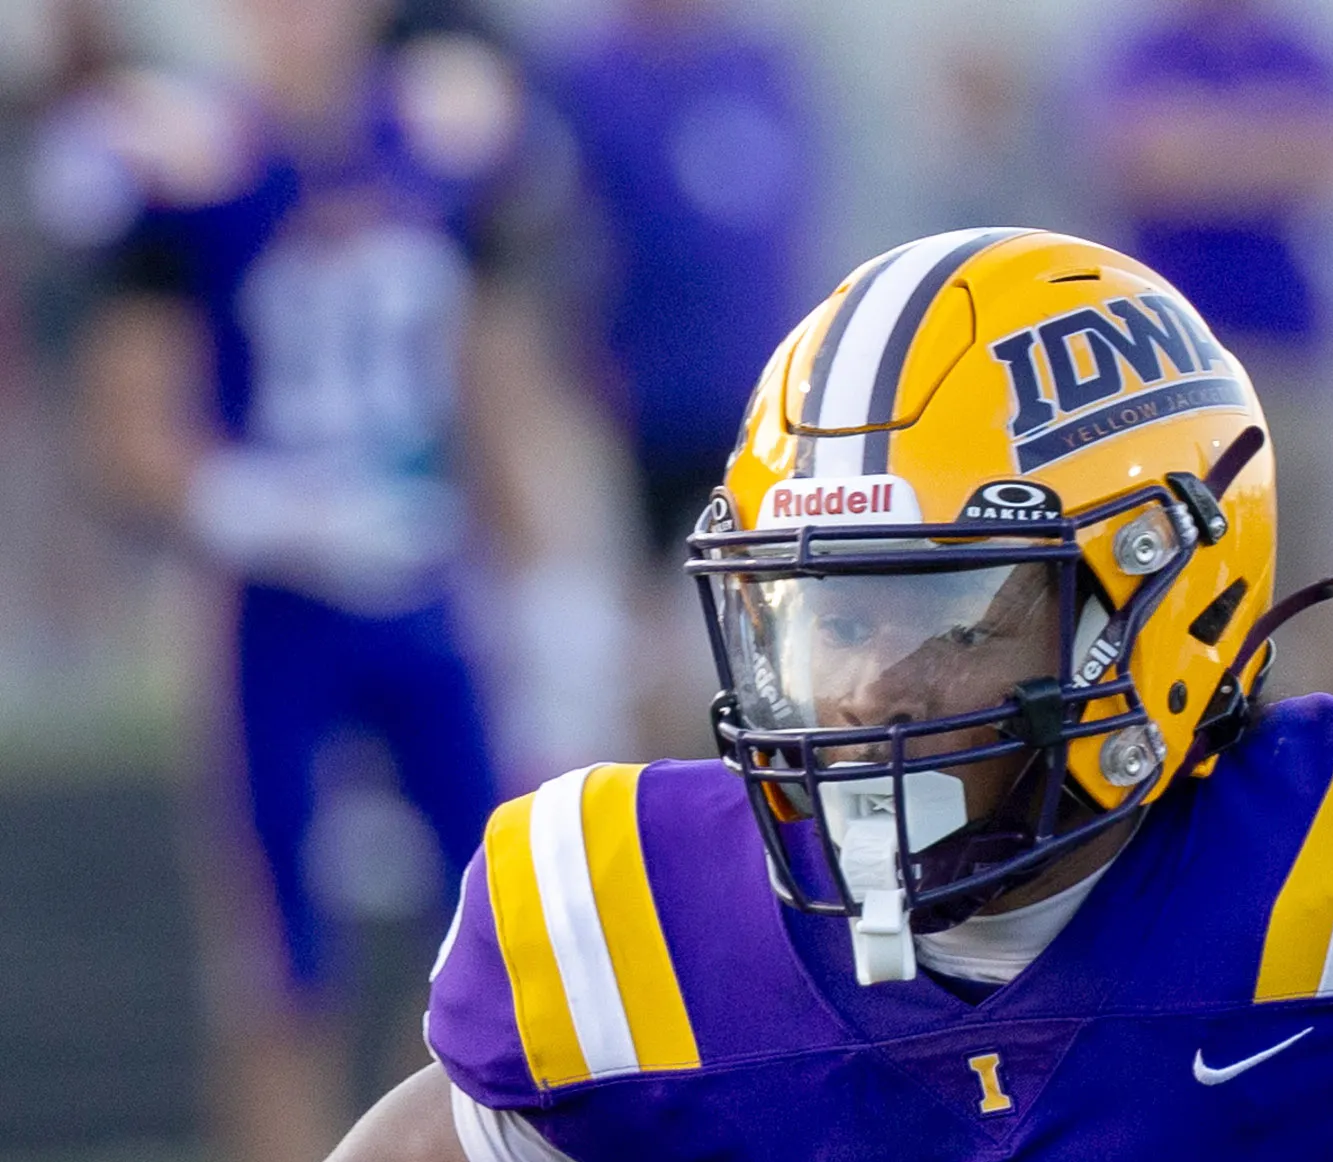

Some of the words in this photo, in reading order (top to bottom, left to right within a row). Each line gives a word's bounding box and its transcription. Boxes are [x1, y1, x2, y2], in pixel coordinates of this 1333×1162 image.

[987, 292, 1236, 440] IOWA
[1062, 400, 1159, 448] YELLOW
[772, 483, 895, 518] Riddell
[967, 1053, 1013, 1114] I
